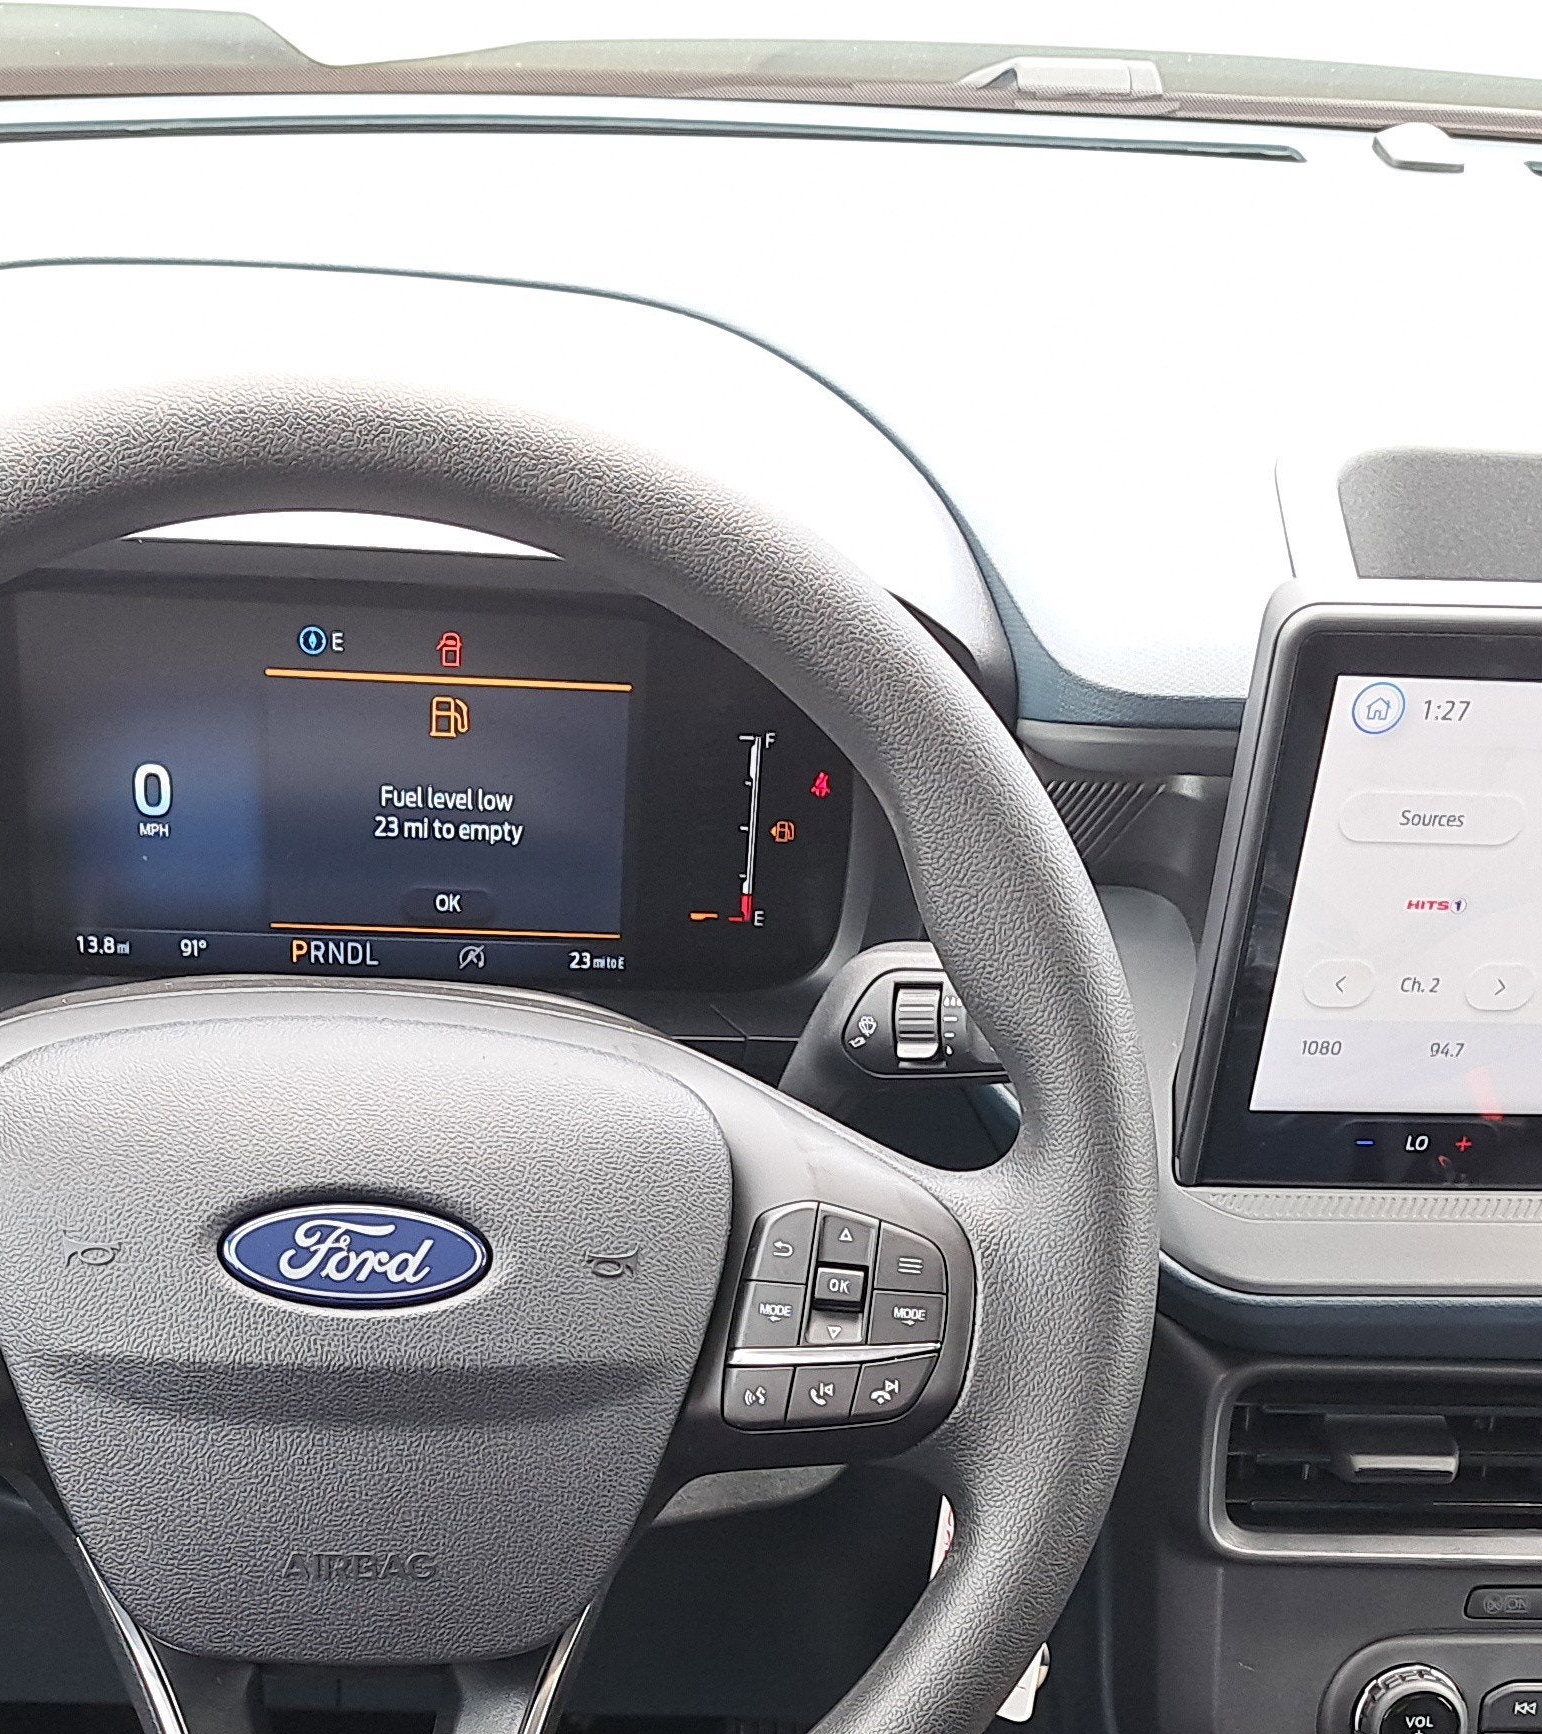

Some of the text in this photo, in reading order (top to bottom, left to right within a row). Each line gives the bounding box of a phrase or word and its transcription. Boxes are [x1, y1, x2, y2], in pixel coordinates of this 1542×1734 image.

[331, 633, 345, 651] E
[1424, 699, 1471, 721] 1:27
[765, 732, 776, 748] F
[133, 763, 173, 817] 0
[381, 785, 514, 812] Fuel level low
[1399, 809, 1465, 828] Sources
[139, 823, 170, 838] MPH
[373, 815, 524, 846] 23 mi to empty
[435, 894, 461, 913] OK
[1407, 900, 1450, 910] HITS
[754, 910, 764, 927] E
[569, 952, 591, 969] 23
[1400, 977, 1440, 993] Ch. 2
[1302, 1040, 1342, 1056] 1080
[1405, 1135, 1429, 1151] LO
[279, 1219, 435, 1284] Ford
[829, 1279, 850, 1294] OK
[759, 1303, 792, 1317] MODE
[893, 1307, 927, 1320] MODE
[281, 1552, 436, 1582] AIRBAG
[1405, 1715, 1434, 1728] VOL
